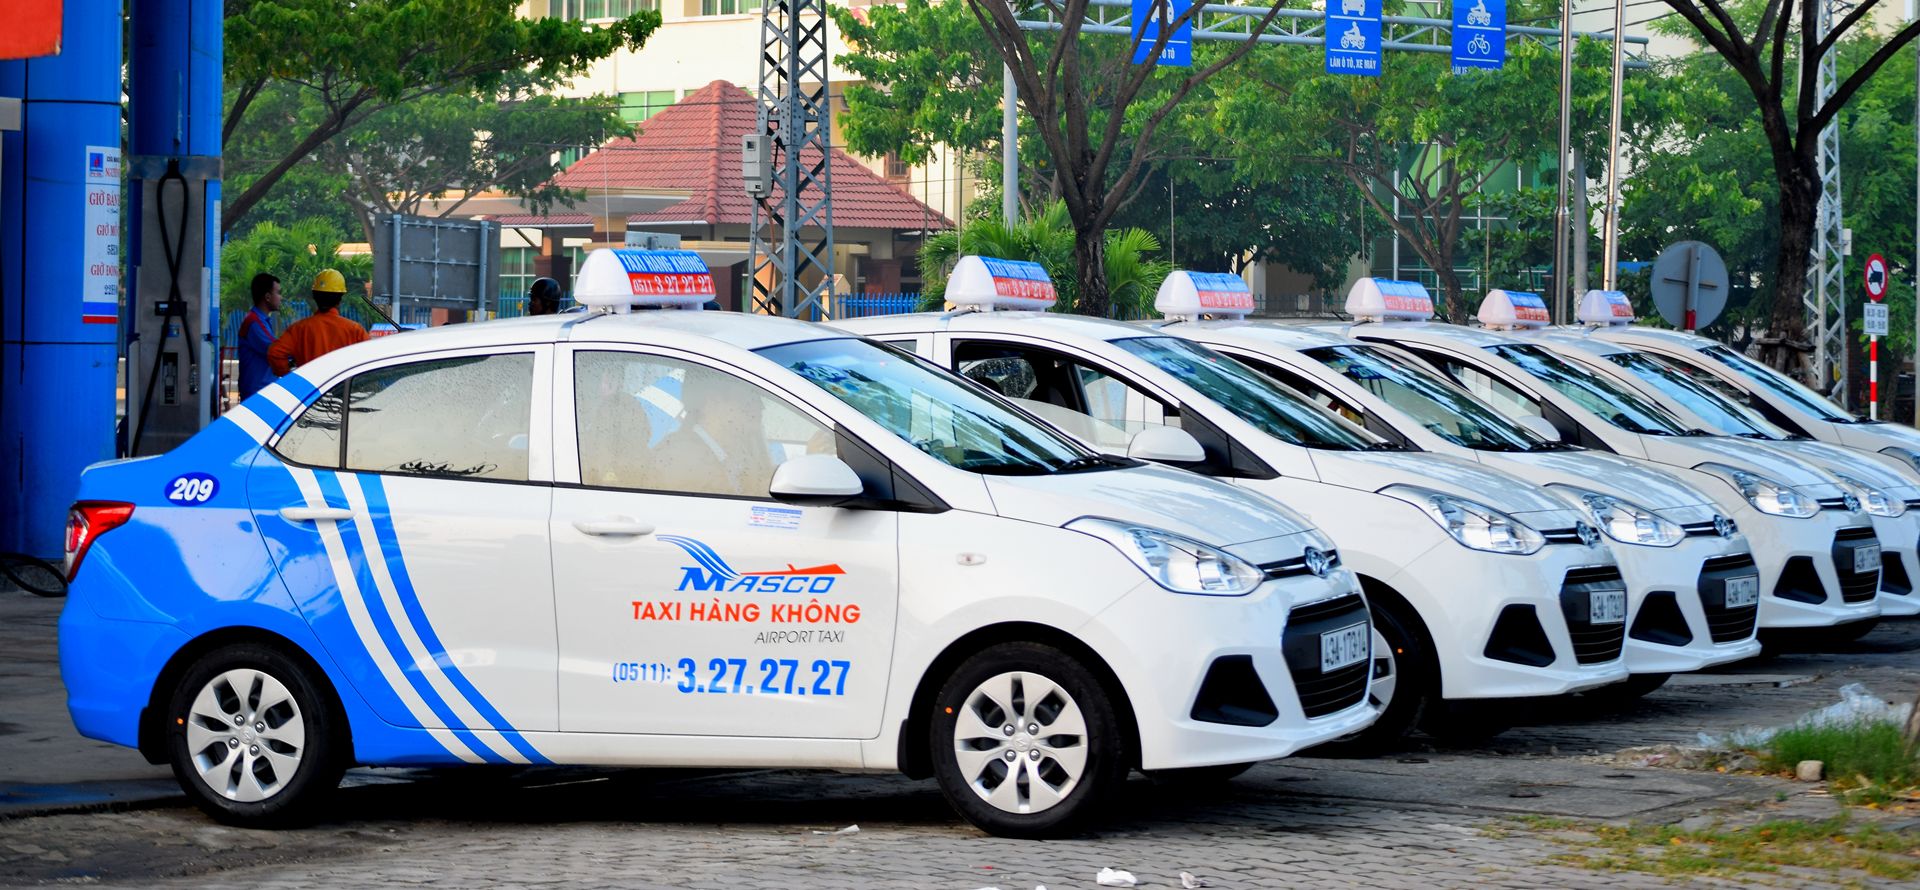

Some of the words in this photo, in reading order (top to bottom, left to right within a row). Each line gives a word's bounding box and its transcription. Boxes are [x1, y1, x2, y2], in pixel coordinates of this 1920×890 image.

[1167, 47, 1175, 59] TÔ
[1329, 56, 1341, 68] LÀN
[1341, 56, 1346, 68] Ô
[1356, 58, 1363, 69] XE
[1363, 57, 1377, 70] MÁY
[620, 253, 646, 271] TAXI
[642, 252, 672, 272] HÀNG
[669, 252, 707, 272] KHÔNG
[633, 278, 653, 293] 0511
[654, 275, 663, 293] 3
[665, 275, 680, 293] 27
[681, 276, 696, 293] 27
[698, 276, 713, 293] 27
[168, 477, 214, 502] 209
[674, 566, 836, 594] MASCO
[631, 601, 681, 621] TAXI
[689, 597, 761, 623] HÀNG
[771, 598, 861, 624] KHÔNG
[754, 630, 814, 644] AIRPORT
[818, 630, 845, 643] TAXI
[612, 662, 671, 683] (0511):
[677, 657, 851, 696] 3.27.27.27
